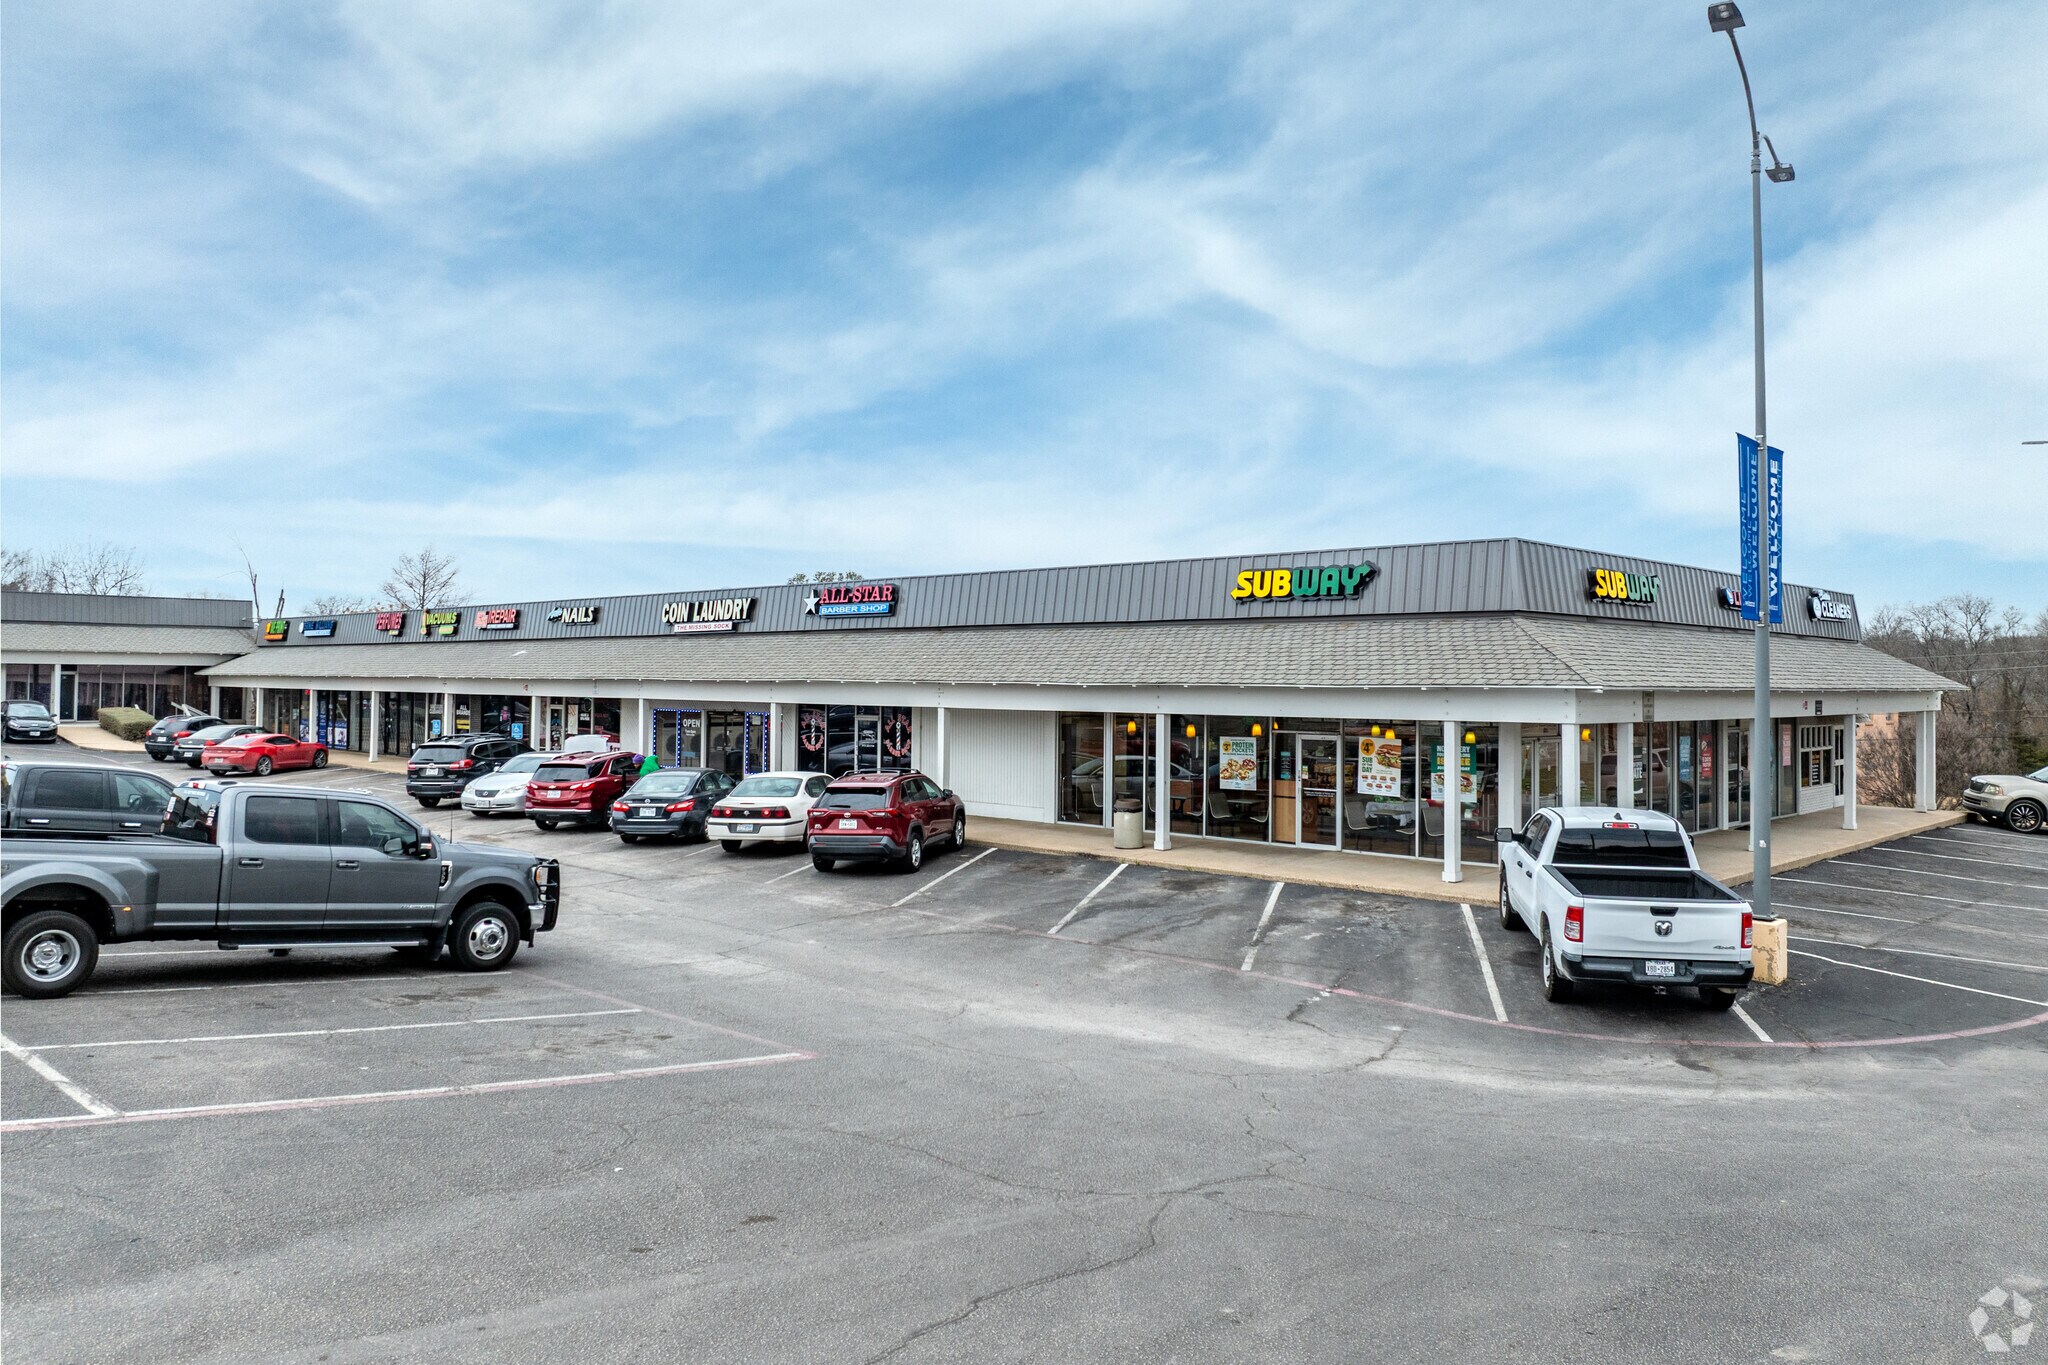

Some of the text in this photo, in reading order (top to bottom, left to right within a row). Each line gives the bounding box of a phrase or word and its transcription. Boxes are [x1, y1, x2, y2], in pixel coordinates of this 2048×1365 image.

[1770, 459, 1779, 598] WELCOME
[1230, 563, 1372, 600] SUBWAY
[1595, 568, 1661, 603] SUBWAY
[819, 584, 893, 604] ALL-STAR
[561, 606, 594, 622] NAILS
[661, 597, 752, 623] COIN LAUNDRY
[821, 604, 887, 614] BARBER SHOP
[1821, 601, 1852, 620] CLEANERS
[426, 611, 458, 625] VACUUMS
[682, 718, 701, 728] OPEN
[1231, 741, 1254, 750] PROTEIN
[1361, 756, 1373, 764] SUB
